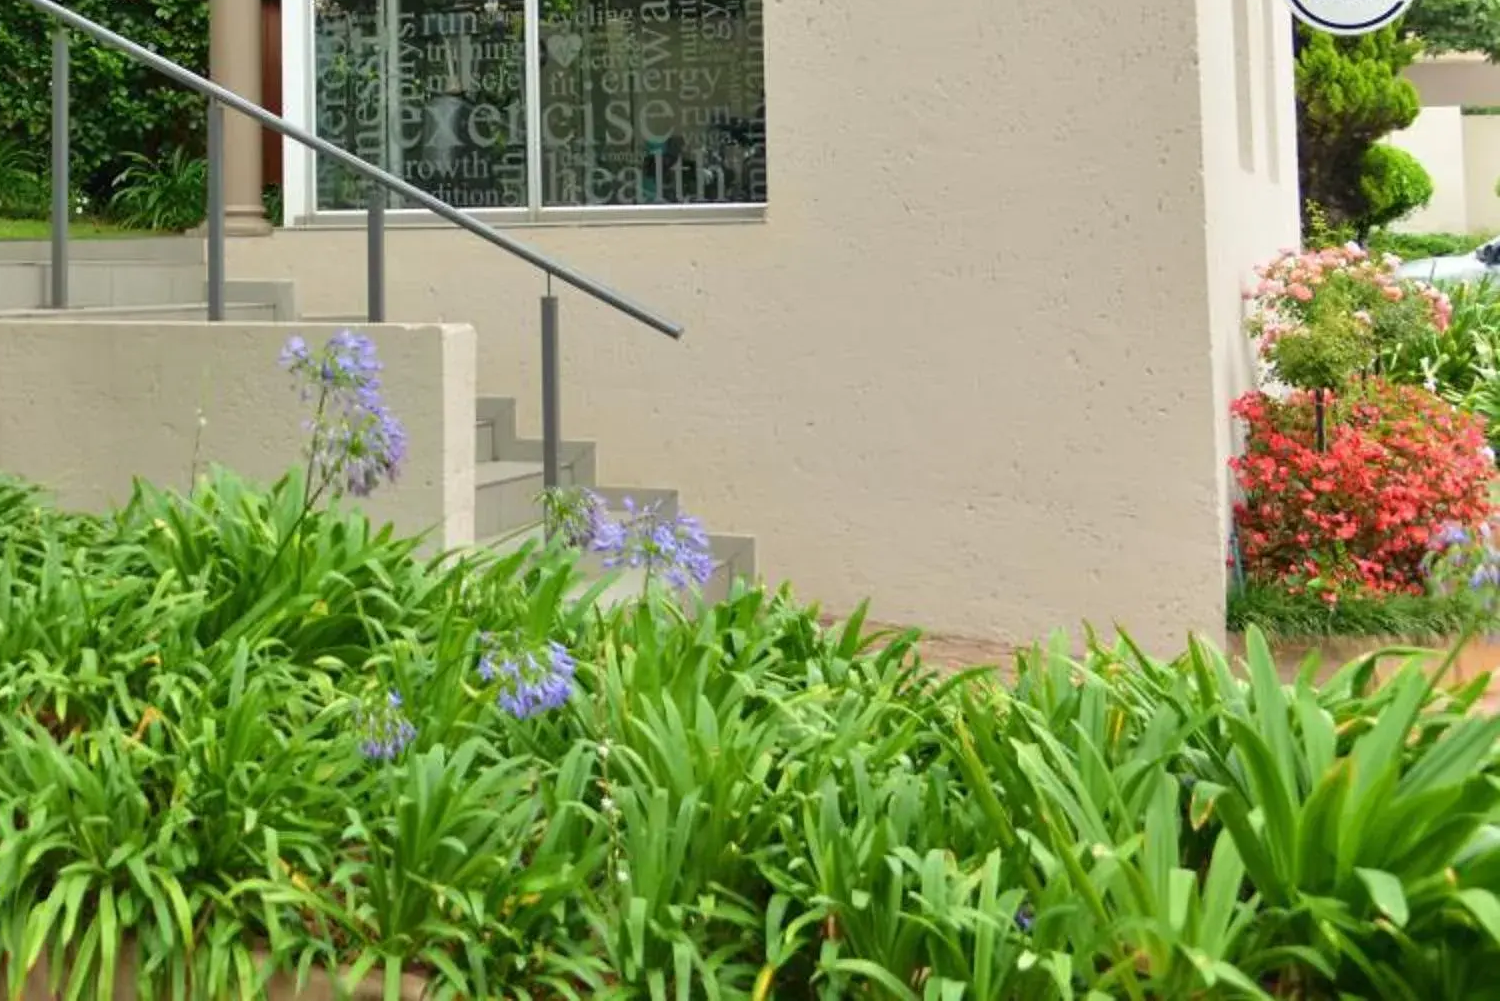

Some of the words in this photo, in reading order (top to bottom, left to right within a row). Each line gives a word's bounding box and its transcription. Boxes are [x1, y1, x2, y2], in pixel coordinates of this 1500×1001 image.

[420, 12, 481, 36] run
[547, 3, 634, 35] cycling
[425, 36, 523, 69] traning
[548, 70, 578, 97] fit
[600, 65, 721, 101] energy
[390, 81, 676, 150] exercise
[679, 105, 732, 126] run
[544, 147, 731, 204] health
